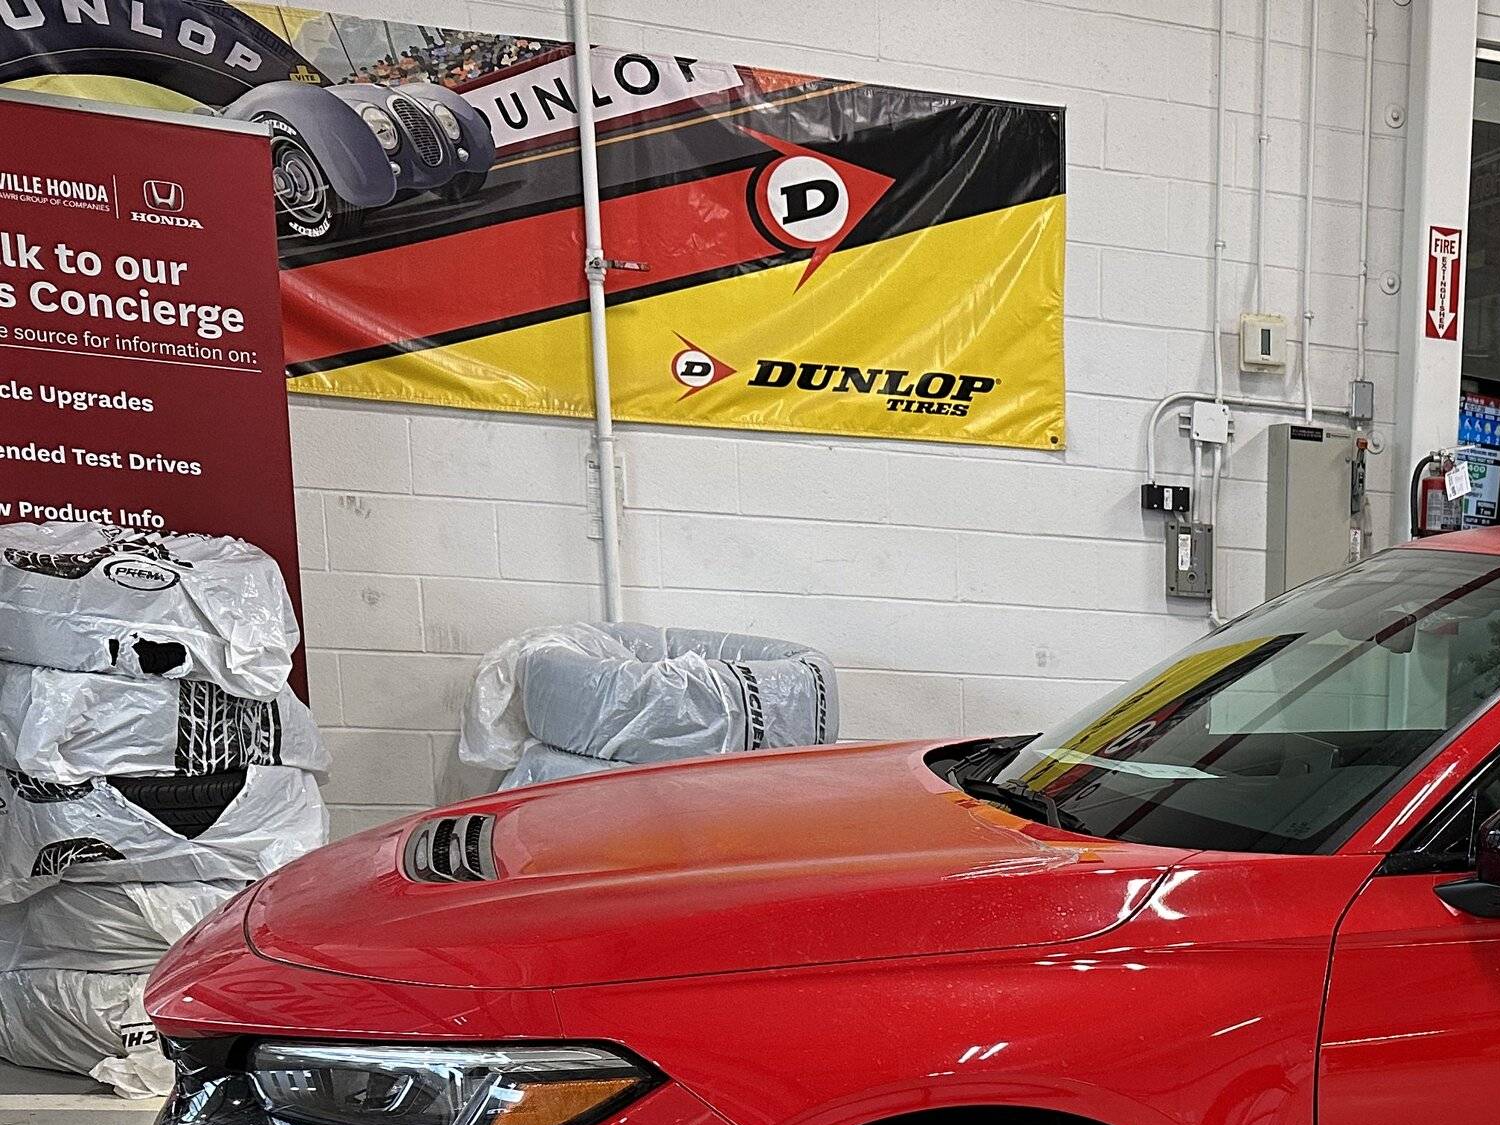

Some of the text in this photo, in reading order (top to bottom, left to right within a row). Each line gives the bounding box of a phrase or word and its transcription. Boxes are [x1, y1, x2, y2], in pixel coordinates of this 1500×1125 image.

[46, 178, 109, 203] HONDA
[779, 179, 840, 225] D
[49, 198, 61, 206] OF
[62, 199, 110, 212] COMPANIES
[130, 211, 204, 230] HONDA
[0, 231, 188, 286] lk to our
[1434, 238, 1456, 255] FIRE
[1438, 256, 1448, 331] EXTINGUISHER
[29, 281, 244, 339] Concierge
[14, 325, 78, 346] source
[83, 331, 110, 349] for
[116, 334, 223, 361] information
[228, 349, 257, 364] on:
[747, 359, 996, 402] DUNLOP
[40, 384, 154, 412] Upgrades
[886, 399, 970, 418] TIRES
[72, 448, 123, 469] Test
[129, 453, 202, 476] Drives
[19, 501, 113, 526] Product
[120, 509, 165, 529] Info
